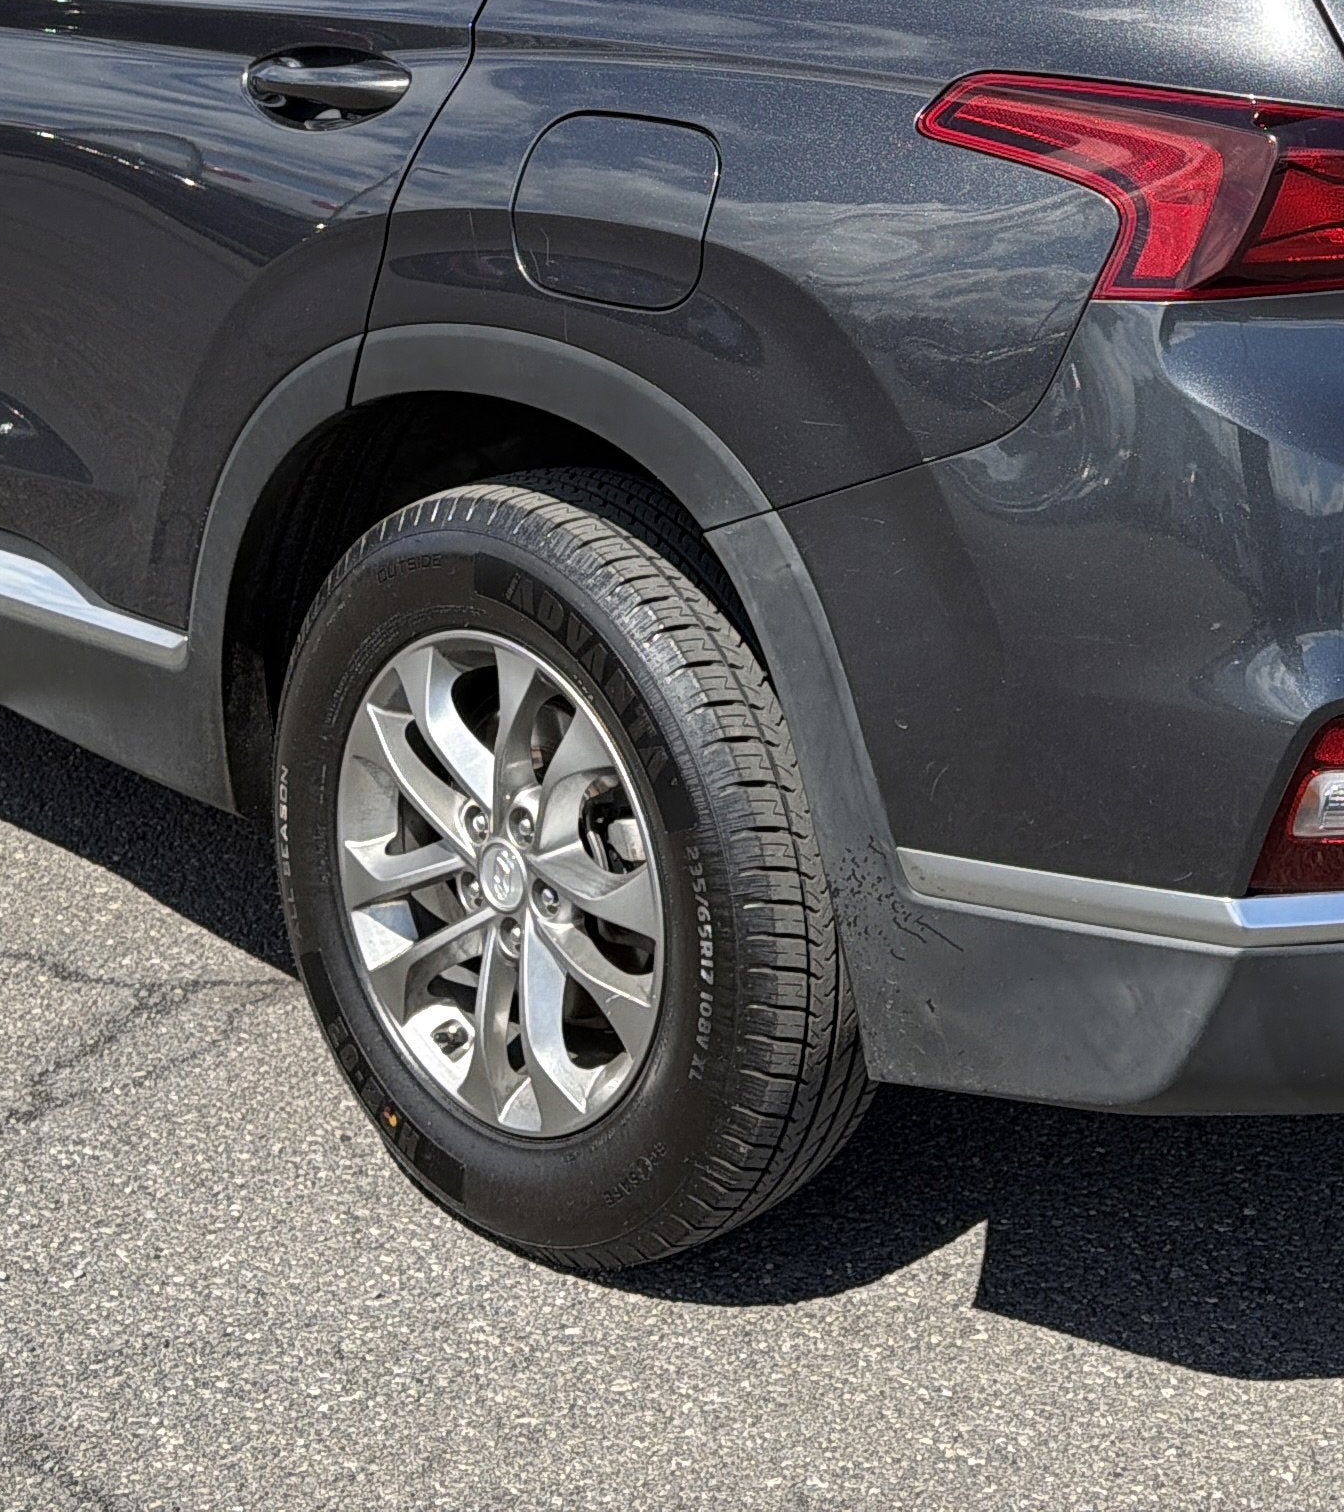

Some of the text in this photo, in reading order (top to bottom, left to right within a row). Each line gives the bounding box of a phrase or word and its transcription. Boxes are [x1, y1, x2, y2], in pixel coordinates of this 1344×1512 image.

[377, 554, 442, 583] OUTSIDE
[504, 572, 670, 780] ADVANTA
[280, 765, 302, 941] ALL SEASON
[686, 845, 714, 1082] 235/65R17 108V XL
